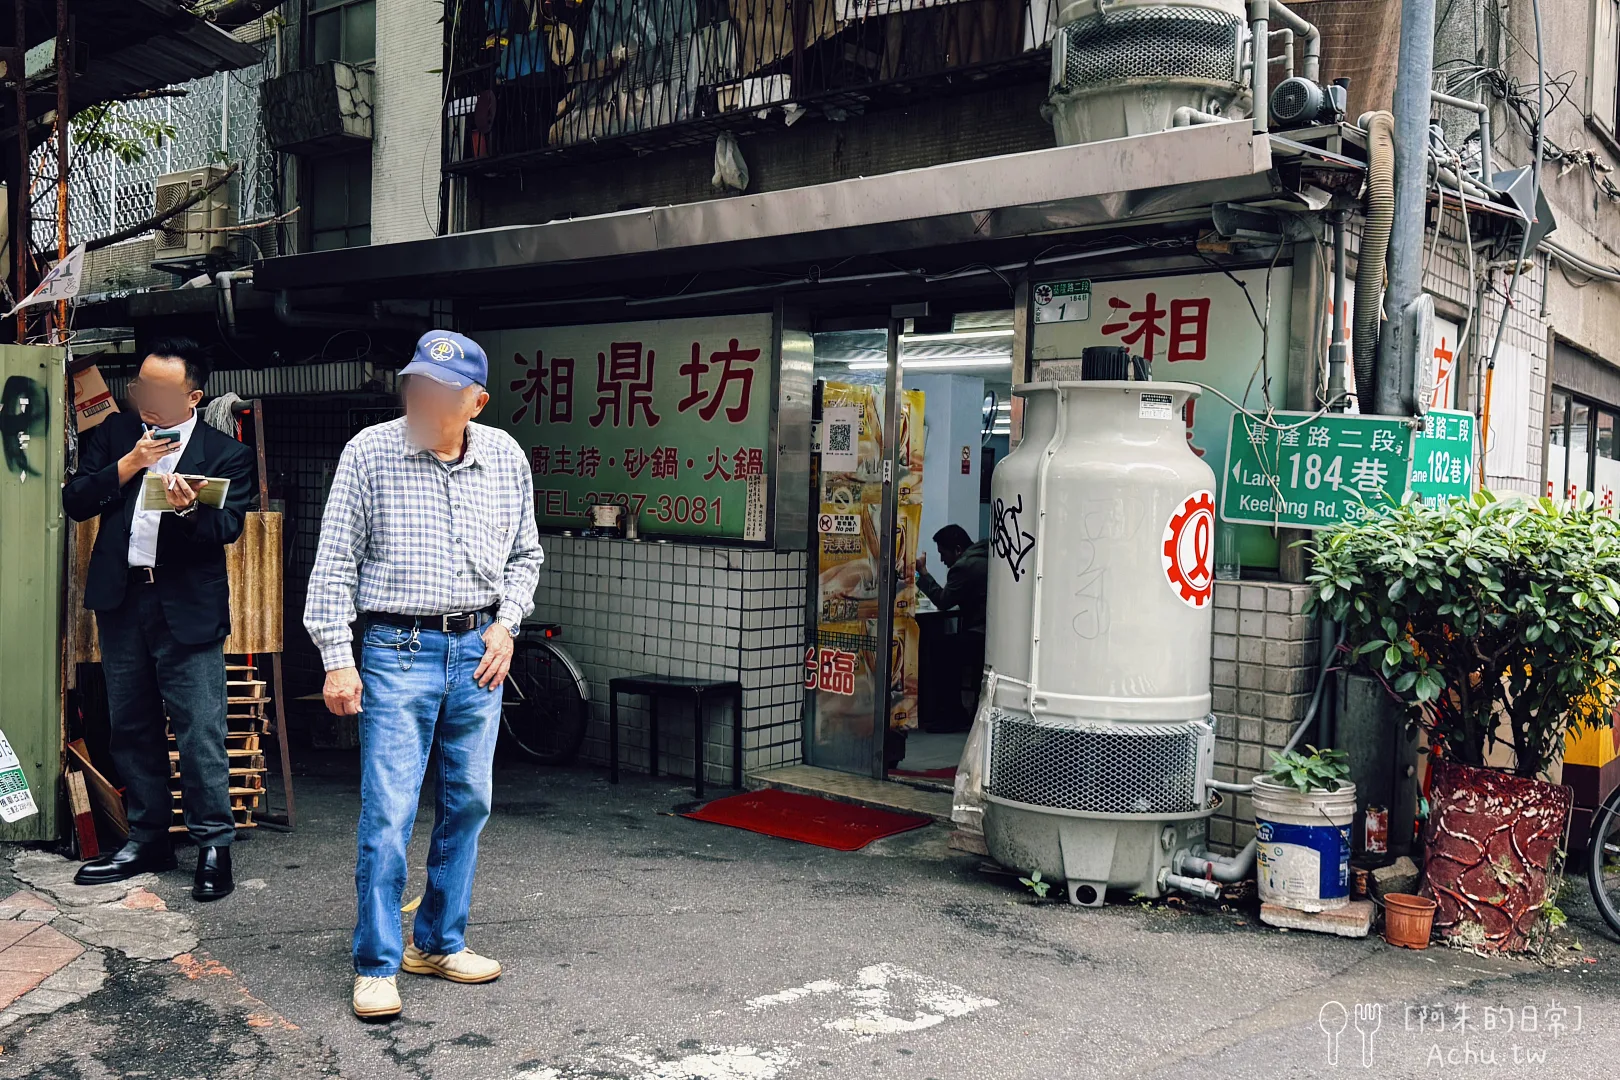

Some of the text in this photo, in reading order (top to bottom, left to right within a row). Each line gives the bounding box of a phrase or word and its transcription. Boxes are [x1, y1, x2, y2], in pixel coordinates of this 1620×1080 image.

[1058, 303, 1067, 320] 1
[510, 337, 761, 428] 湘鼎坊
[1247, 421, 1397, 453] 基隆路二段
[1242, 452, 1389, 493] Lane 184巷
[1427, 450, 1462, 484] 182巷
[1239, 494, 1308, 519] KeeLung
[1314, 500, 1339, 518] Rd.
